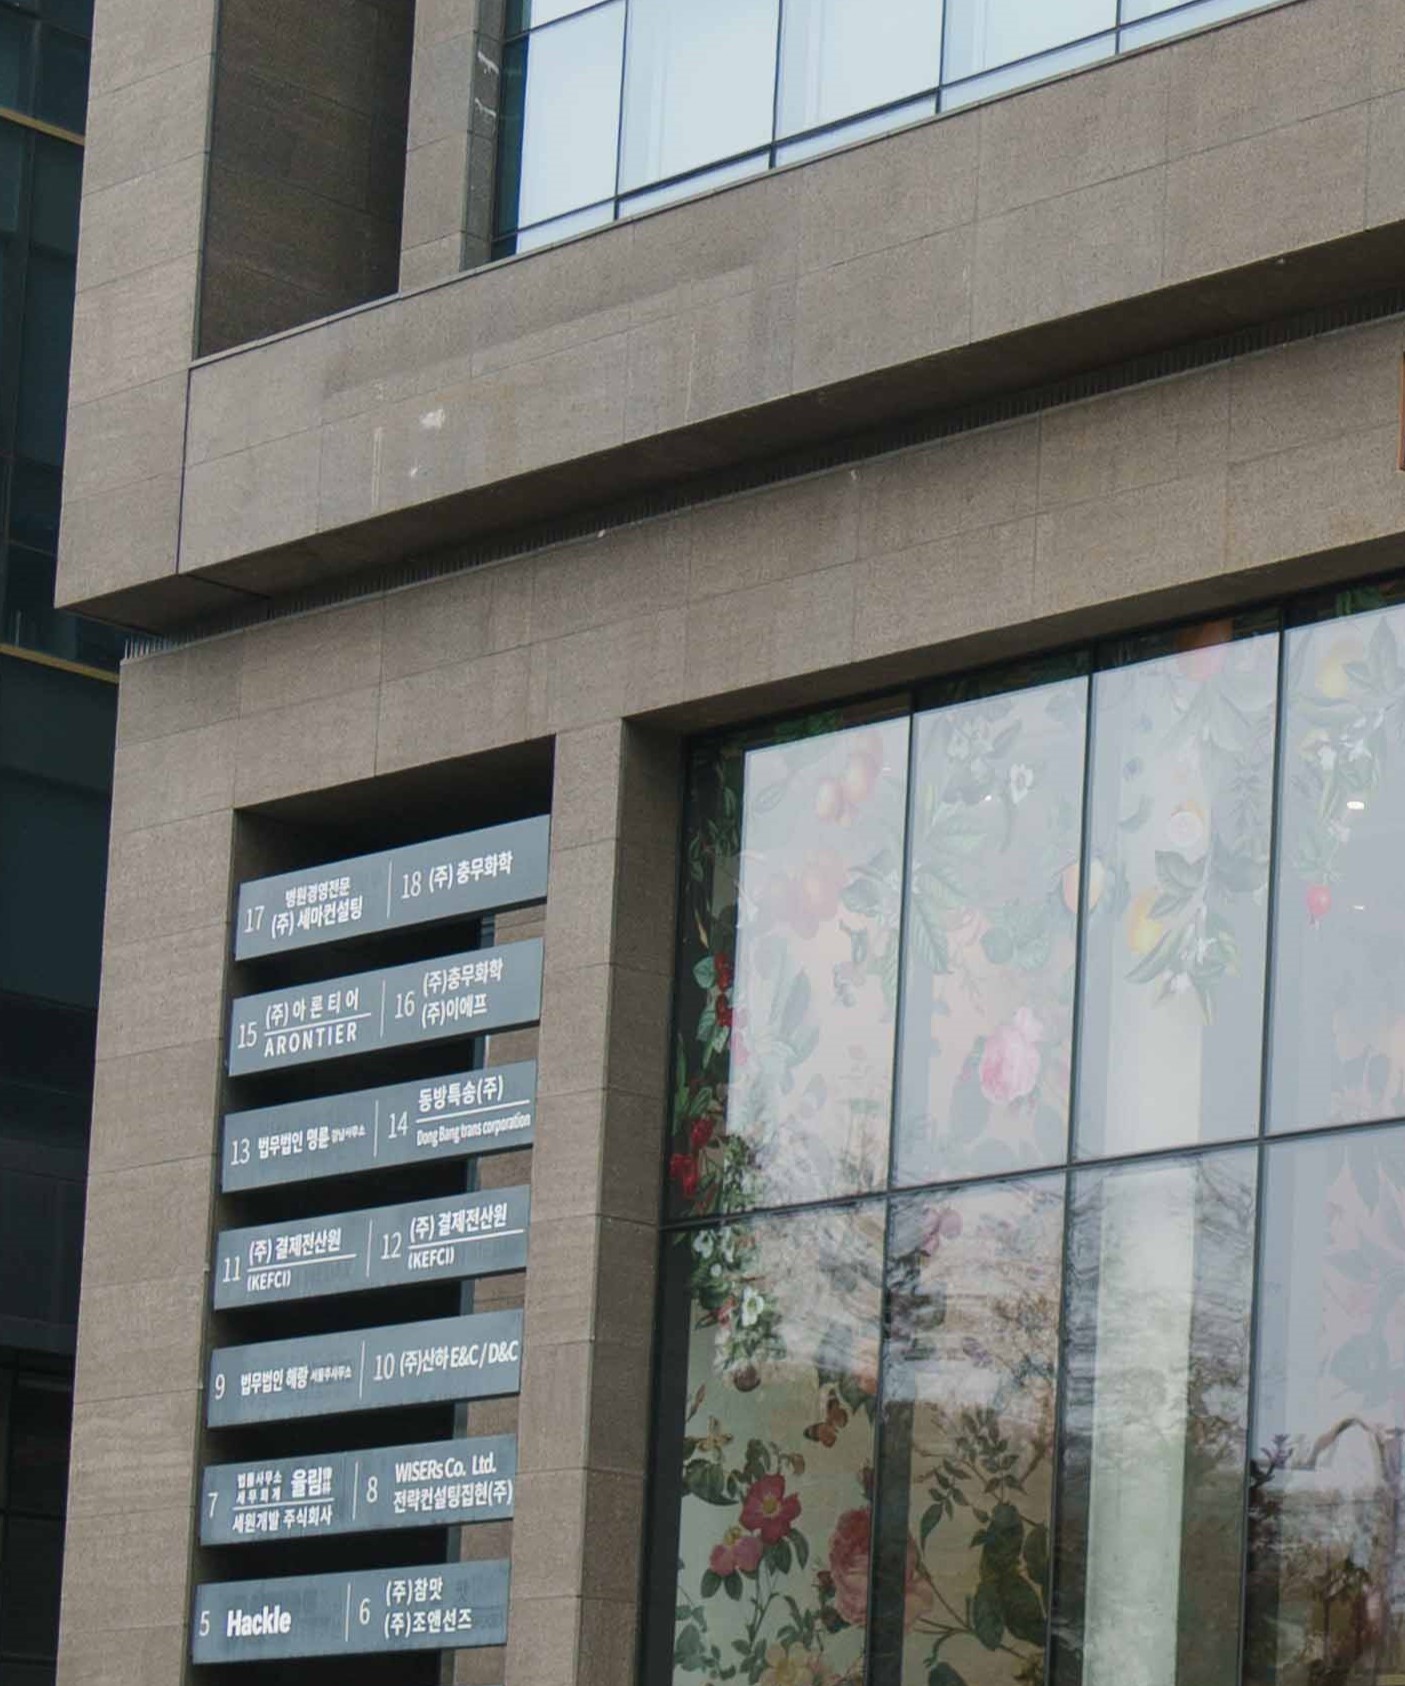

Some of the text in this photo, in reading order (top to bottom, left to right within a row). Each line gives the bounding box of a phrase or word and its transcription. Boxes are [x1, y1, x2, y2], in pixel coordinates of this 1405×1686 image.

[402, 850, 513, 899] 18 (주) 충무화학
[244, 895, 363, 939] 17 (주) 세마컨설팅
[395, 957, 503, 1019] 16 (주)충무화학
[237, 1021, 257, 1049] 15
[266, 1001, 289, 1030] (주)
[264, 1022, 357, 1058] ARONTIER
[388, 1074, 503, 1139] 14 동방특송(주)
[417, 1111, 531, 1147] Dong Bang trans corporation
[231, 1138, 250, 1165] 13
[258, 1130, 303, 1159] 법무법인
[381, 1203, 507, 1260] 12 (주) 결제전산원
[223, 1228, 342, 1282] 11 (주) 결제전산원
[408, 1247, 455, 1270] (KEFCI)
[247, 1269, 291, 1291] (KEFCI)
[215, 1374, 225, 1400] 9
[240, 1368, 284, 1396] 법무법인
[374, 1353, 395, 1380] 10
[395, 1451, 496, 1483] WISERs Co. Ltd.
[208, 1492, 218, 1518] 7
[366, 1476, 378, 1503] 8
[232, 1504, 332, 1533] 세원개발 주식회사
[359, 1576, 443, 1625] 6 (주)참맛
[199, 1605, 291, 1637] 5 Hackle
